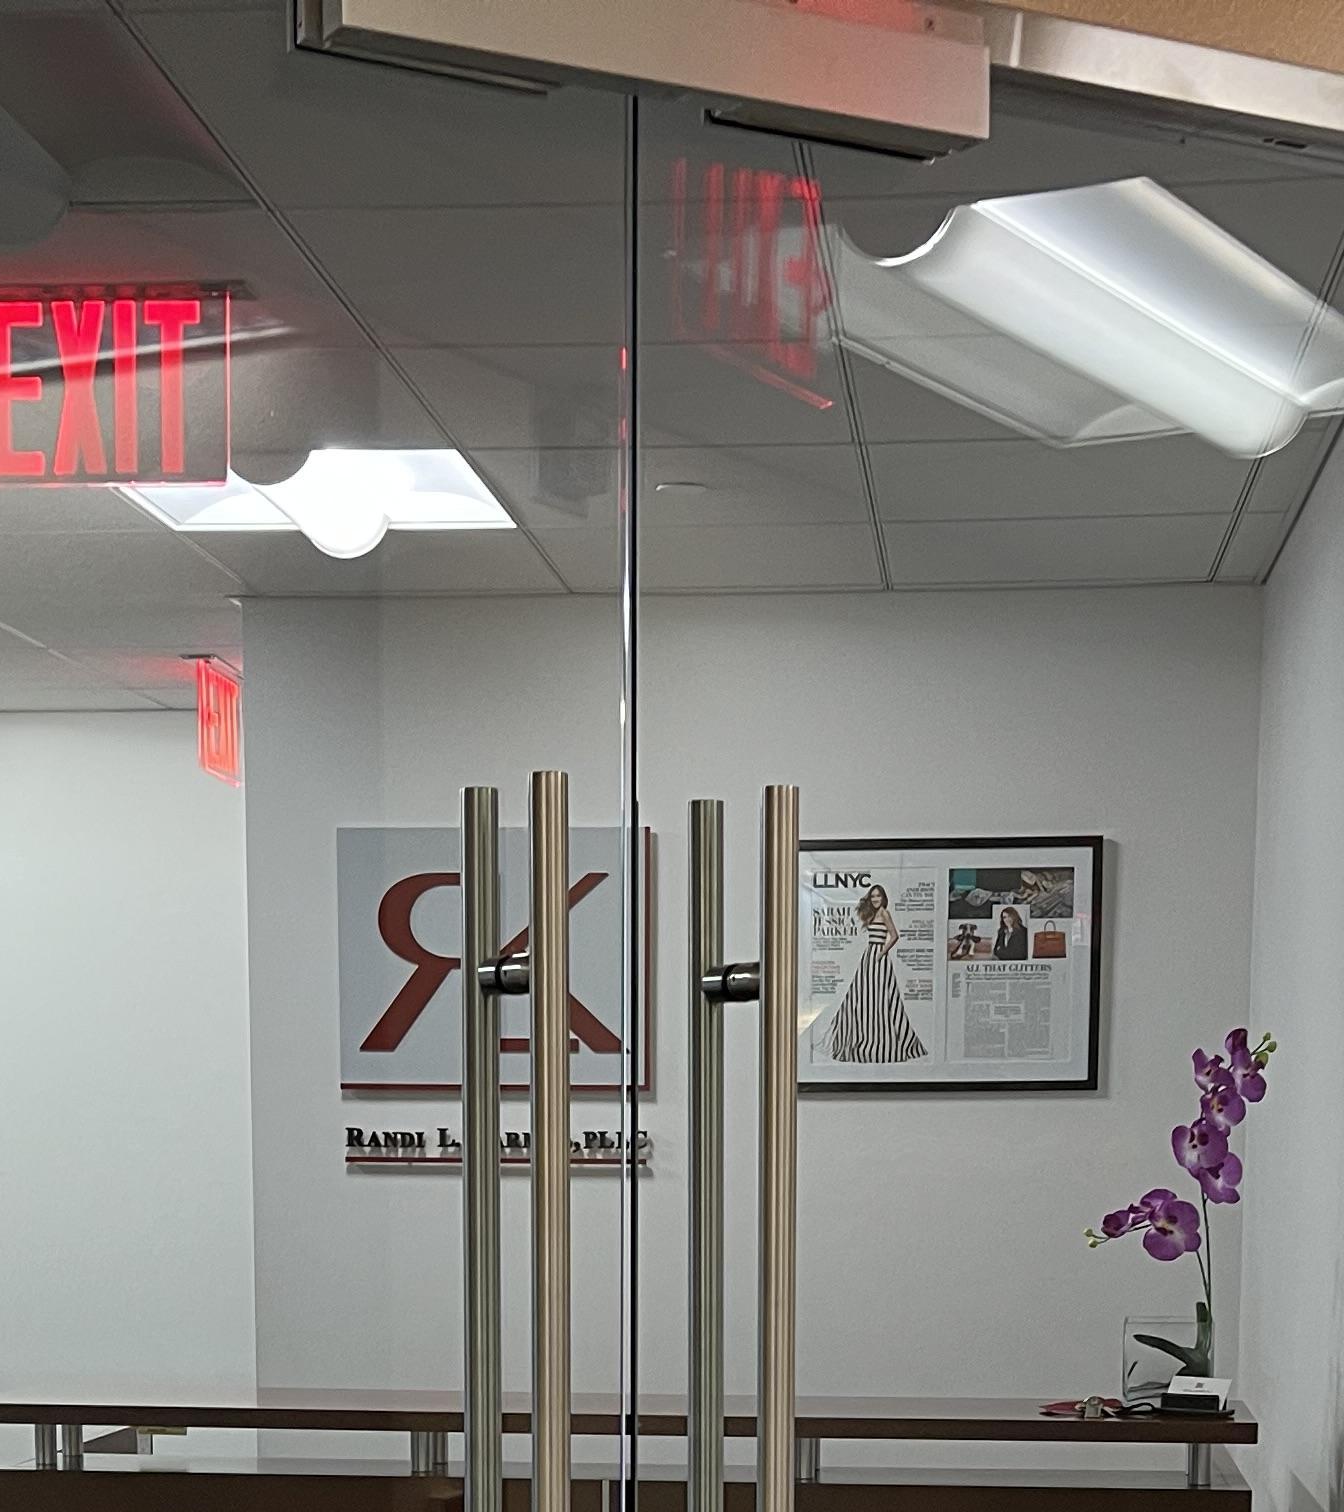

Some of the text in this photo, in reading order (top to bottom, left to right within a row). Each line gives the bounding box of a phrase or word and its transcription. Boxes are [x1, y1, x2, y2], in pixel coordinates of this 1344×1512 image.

[813, 873, 871, 888] LLNYC
[813, 907, 851, 917] SARAH
[813, 927, 858, 936] PARKER
[983, 964, 1007, 972] THAT
[1008, 964, 1052, 972] GLITTERS
[437, 1128, 461, 1147] L.
